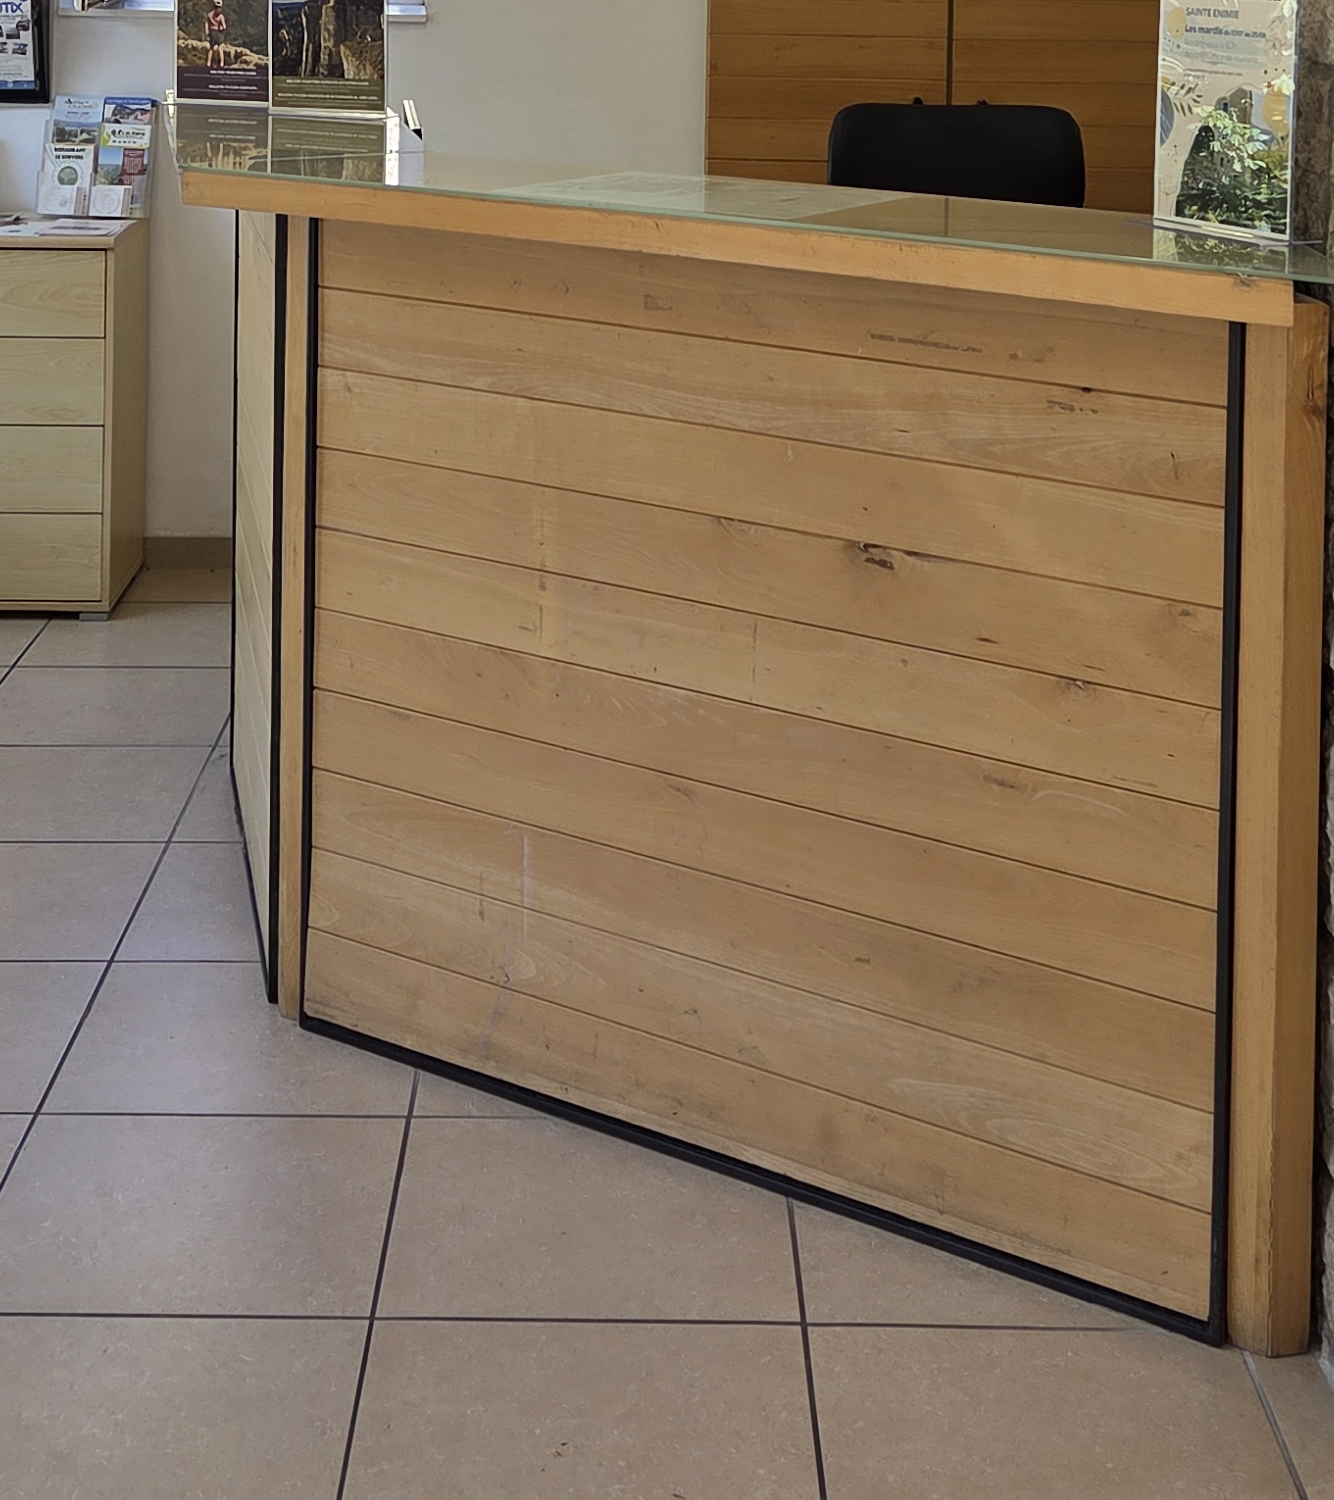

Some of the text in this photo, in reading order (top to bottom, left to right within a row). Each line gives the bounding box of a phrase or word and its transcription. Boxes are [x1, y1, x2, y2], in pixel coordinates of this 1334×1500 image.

[1186, 7, 1211, 17] SAINTE
[1185, 24, 1196, 33] Les
[1198, 26, 1223, 35] mardis
